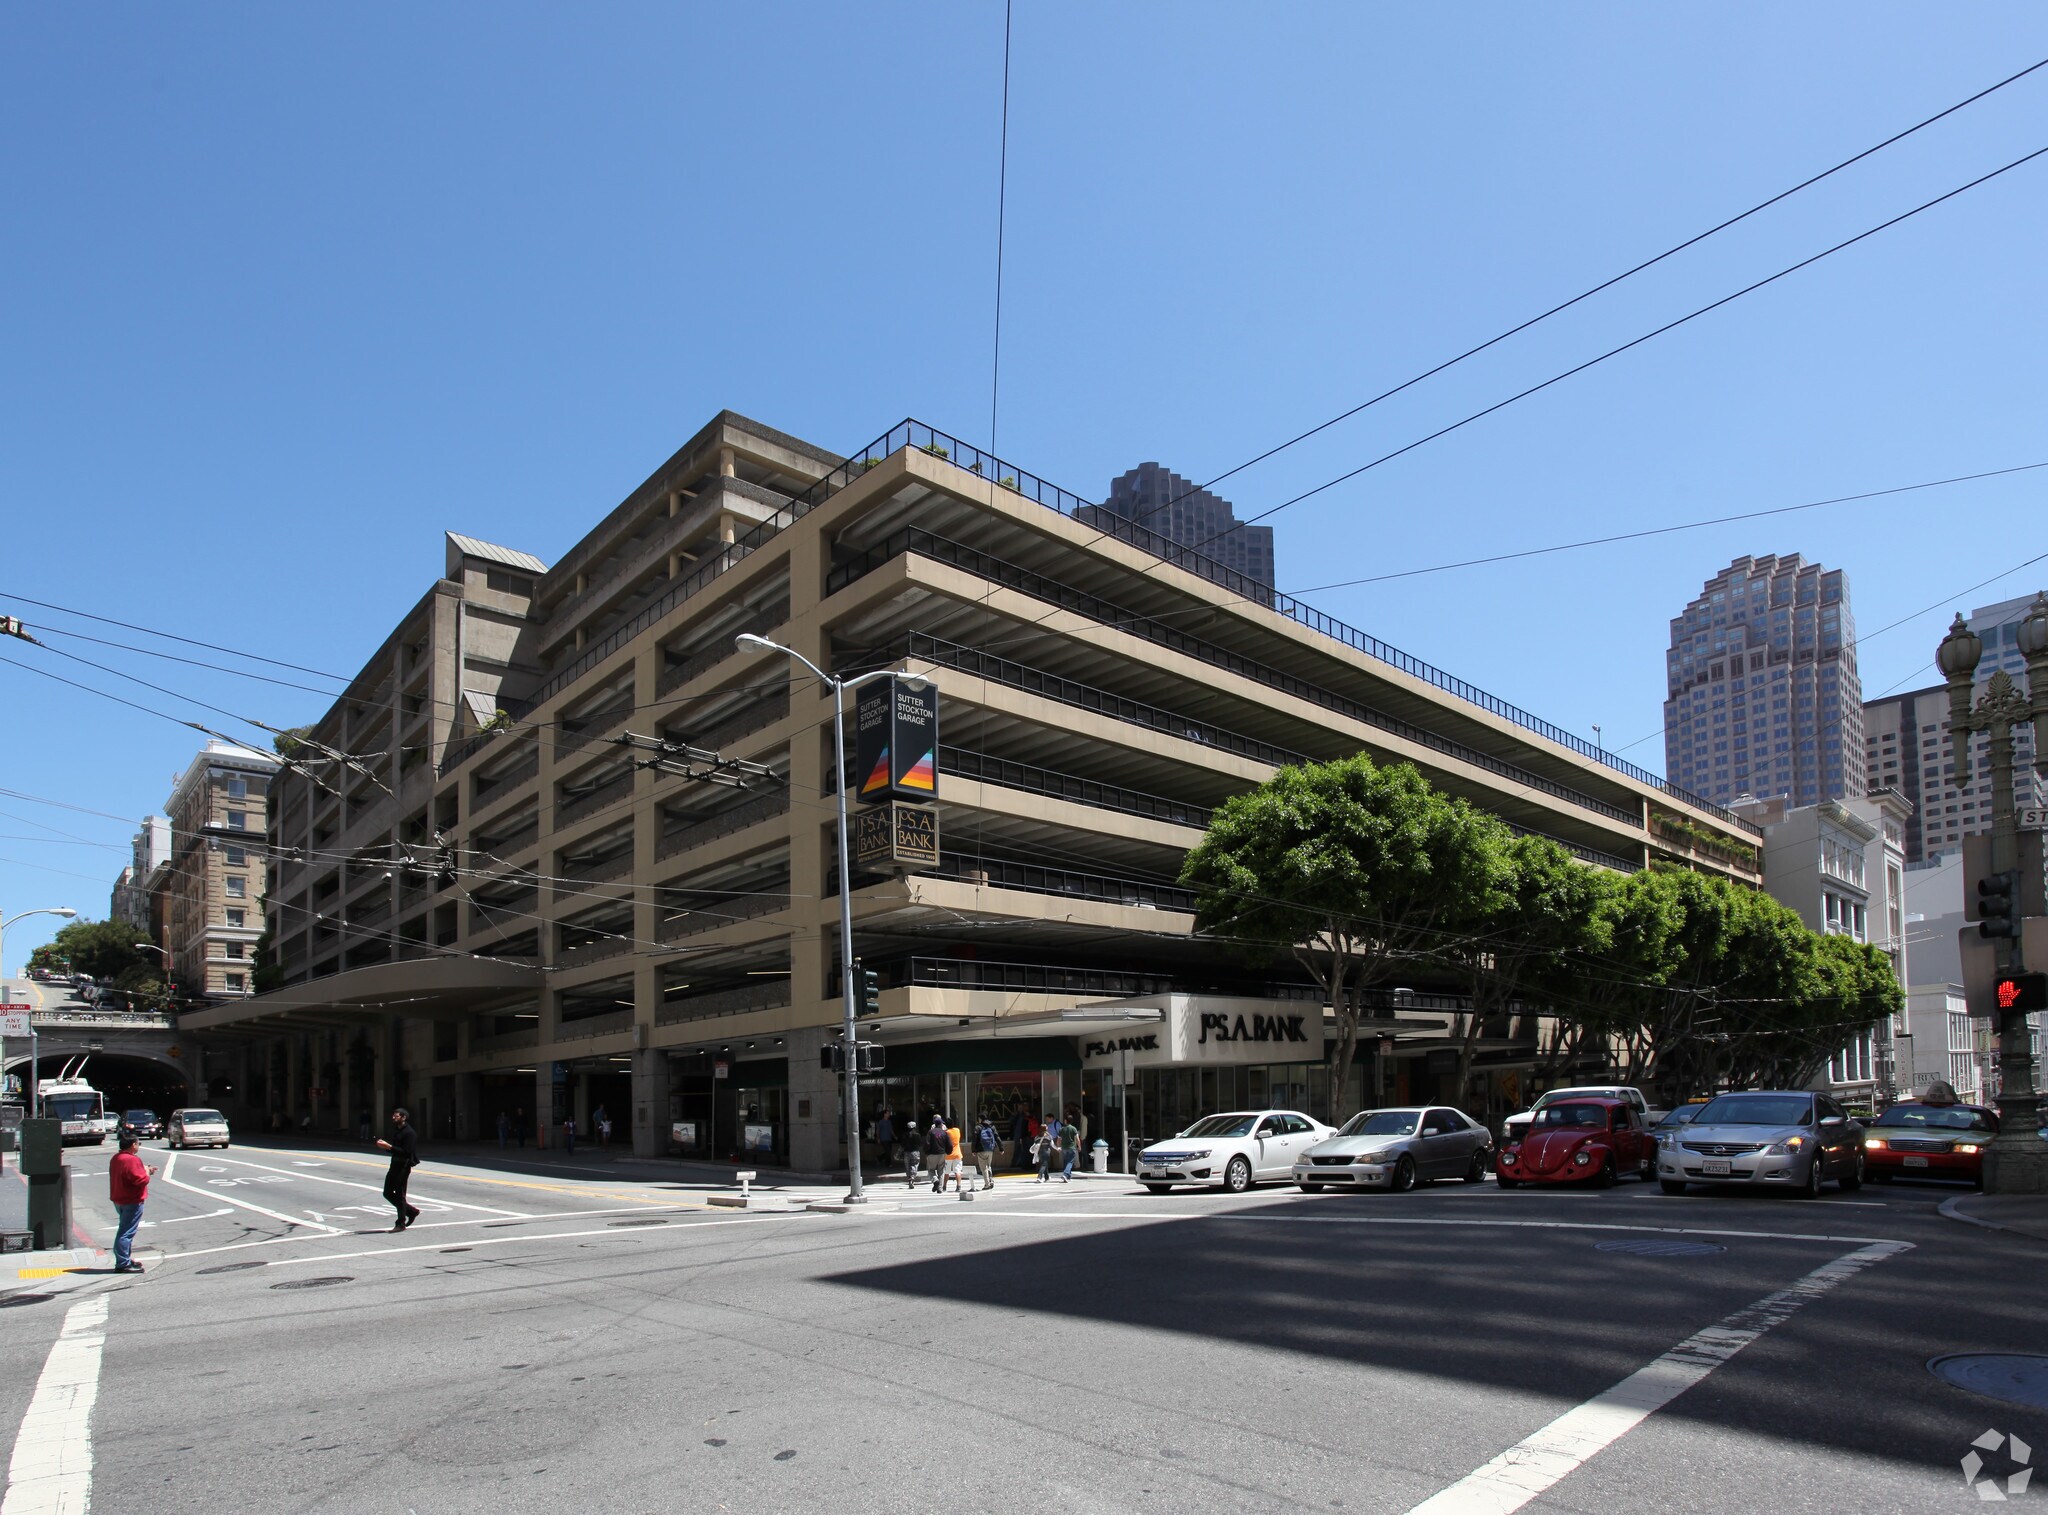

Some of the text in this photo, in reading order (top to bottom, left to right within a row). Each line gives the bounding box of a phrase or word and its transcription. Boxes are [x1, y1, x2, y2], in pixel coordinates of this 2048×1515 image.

[860, 698, 881, 713] SUTTER
[898, 694, 923, 707] SUTTER
[860, 704, 889, 722] STOCKTON
[898, 703, 933, 718] STOCKTON
[860, 716, 882, 731] GARAGE
[898, 712, 925, 726] GARAGE
[861, 831, 889, 851] BANK
[899, 831, 933, 849] BANK
[897, 850, 925, 859] ESTABLISHED
[208, 1175, 294, 1187] BUS
